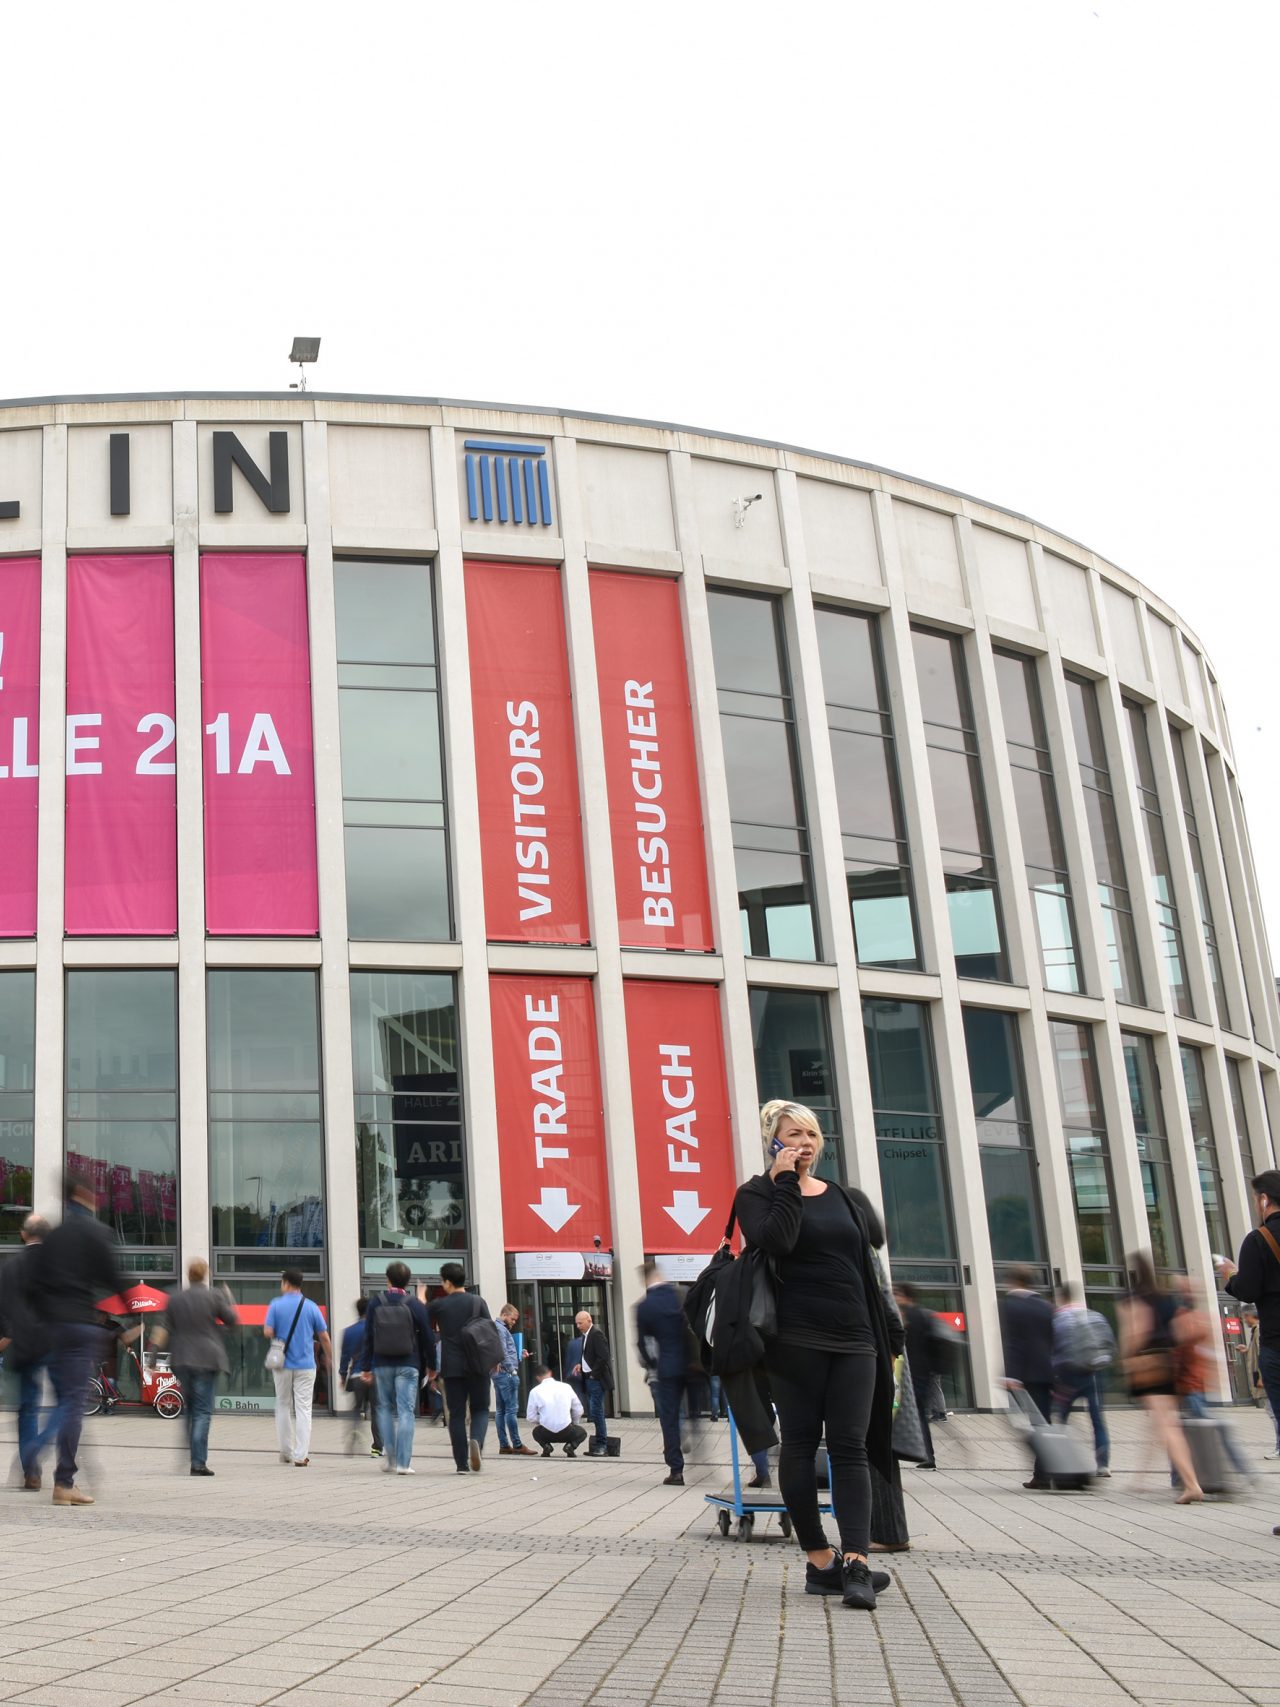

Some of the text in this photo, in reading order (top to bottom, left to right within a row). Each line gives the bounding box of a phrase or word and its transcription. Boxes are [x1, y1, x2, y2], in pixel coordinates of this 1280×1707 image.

[135, 712, 292, 776] 21A
[624, 679, 676, 927] BESUCHER
[506, 700, 553, 922] VISITORS
[525, 994, 569, 1169] TRADE
[658, 1044, 701, 1173] FACH
[883, 1148, 928, 1160] Chipset
[235, 1400, 260, 1410] Bahn
